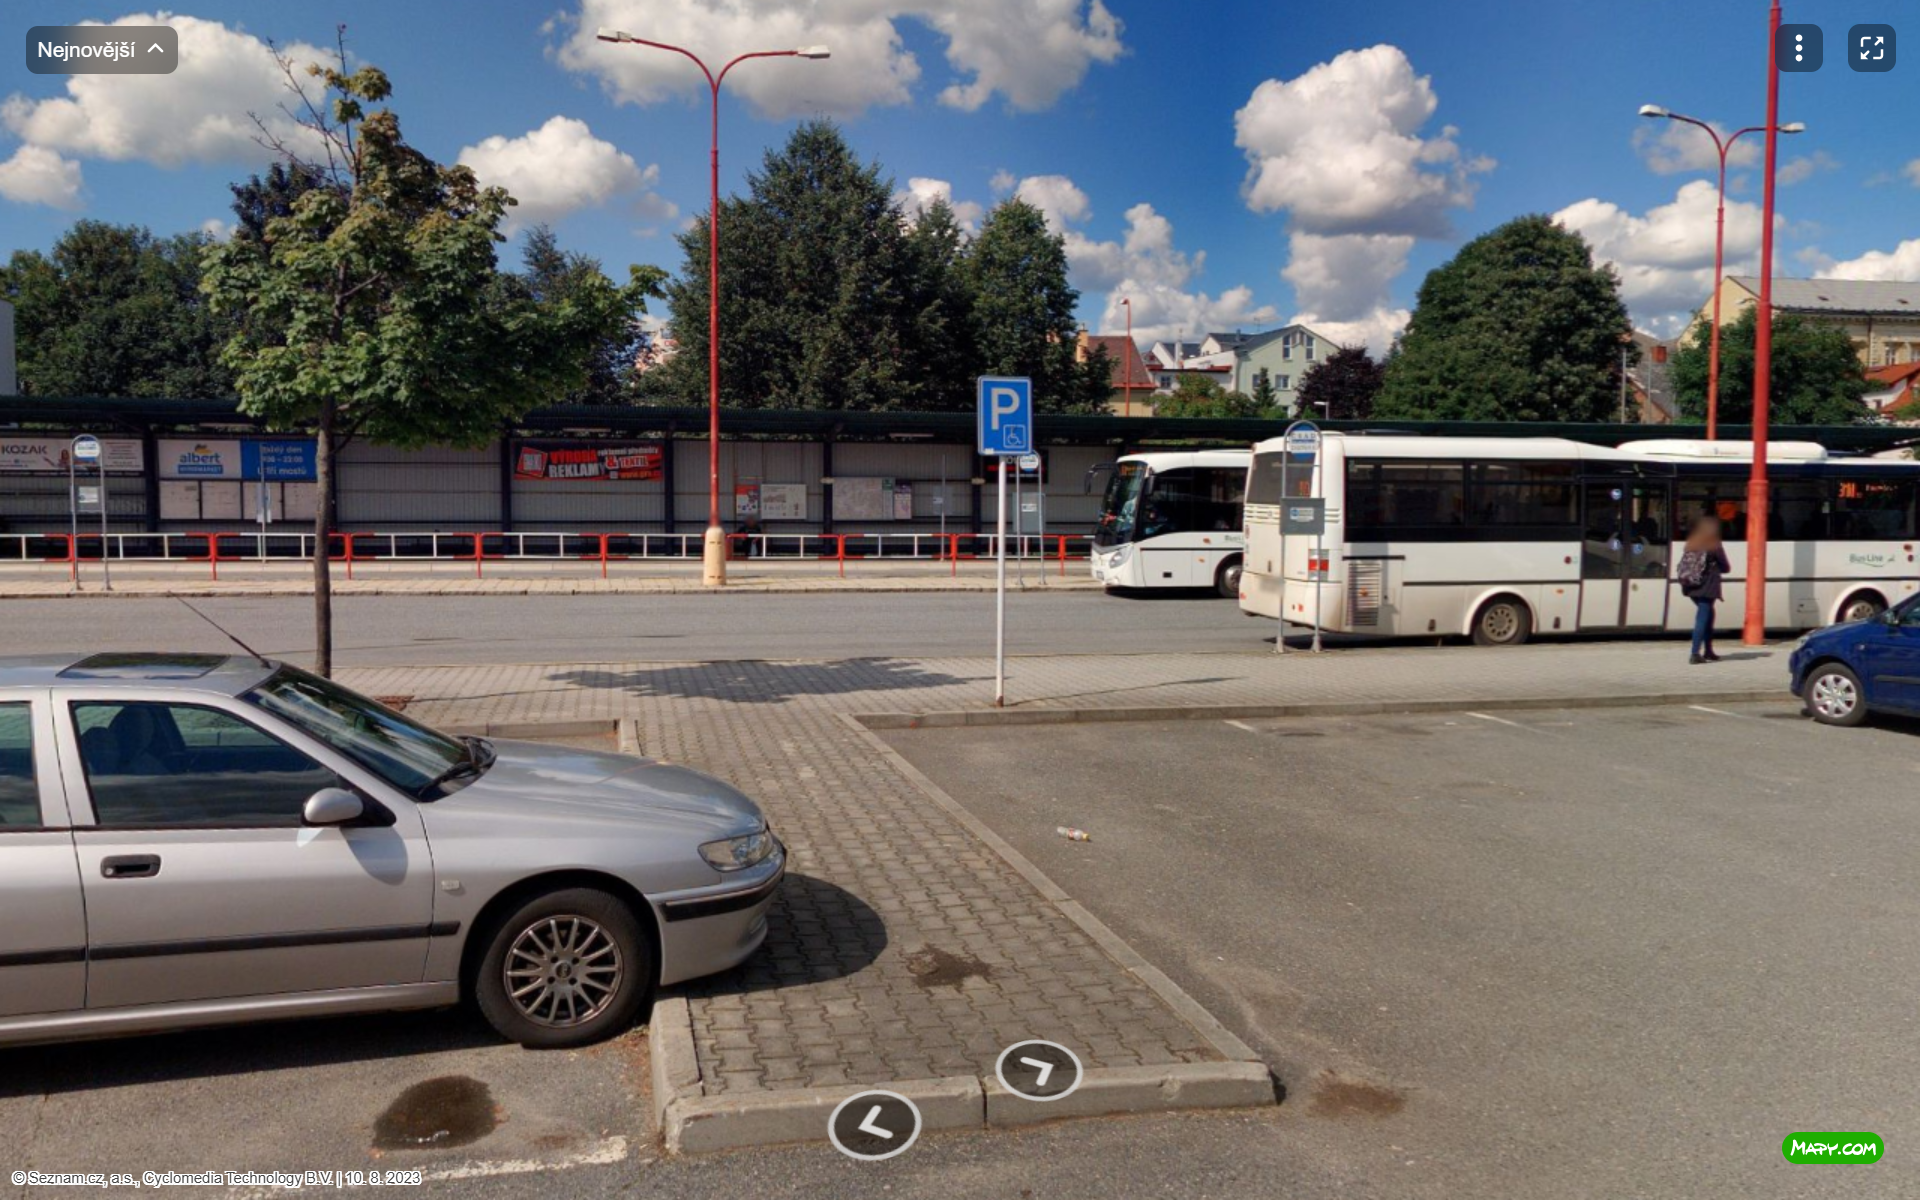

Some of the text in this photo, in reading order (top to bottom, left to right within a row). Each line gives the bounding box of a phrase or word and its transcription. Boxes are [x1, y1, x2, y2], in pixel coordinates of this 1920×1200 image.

[991, 387, 1020, 430] P
[2, 445, 48, 454] KOZAK
[180, 452, 221, 463] albert
[549, 462, 605, 477] REKLAMY
